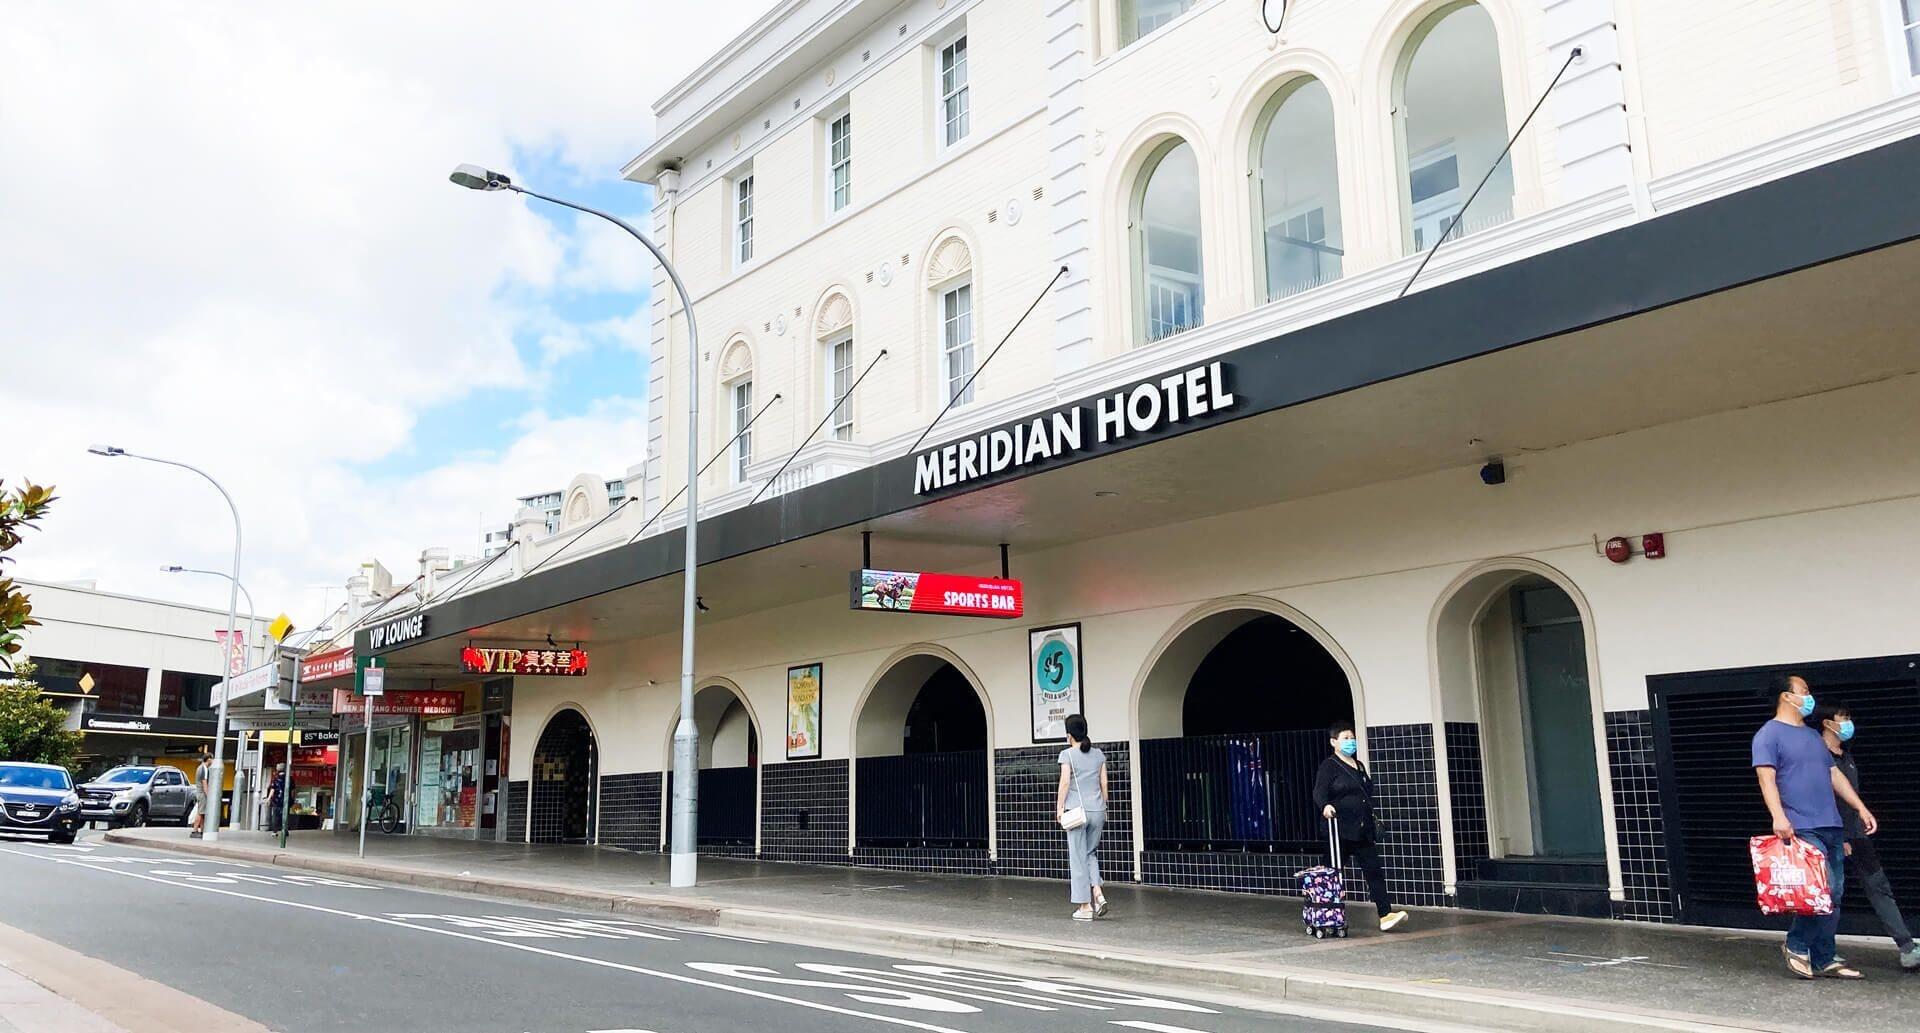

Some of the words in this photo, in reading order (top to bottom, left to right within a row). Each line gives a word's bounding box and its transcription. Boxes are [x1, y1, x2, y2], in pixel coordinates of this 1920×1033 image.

[914, 406, 1082, 495] MERIDIAN
[1096, 361, 1234, 442] HOTEL
[1608, 541, 1622, 549] FIRE
[943, 591, 989, 608] SPORTS
[991, 594, 1016, 611] BAR
[369, 627, 385, 650] VIP
[385, 615, 424, 645] LOUNGE
[480, 648, 523, 673] VIP
[1044, 651, 1064, 685] $5
[392, 705, 422, 713] CHINESE
[424, 705, 457, 714] MEDICINE
[685, 962, 1222, 1013] BUS
